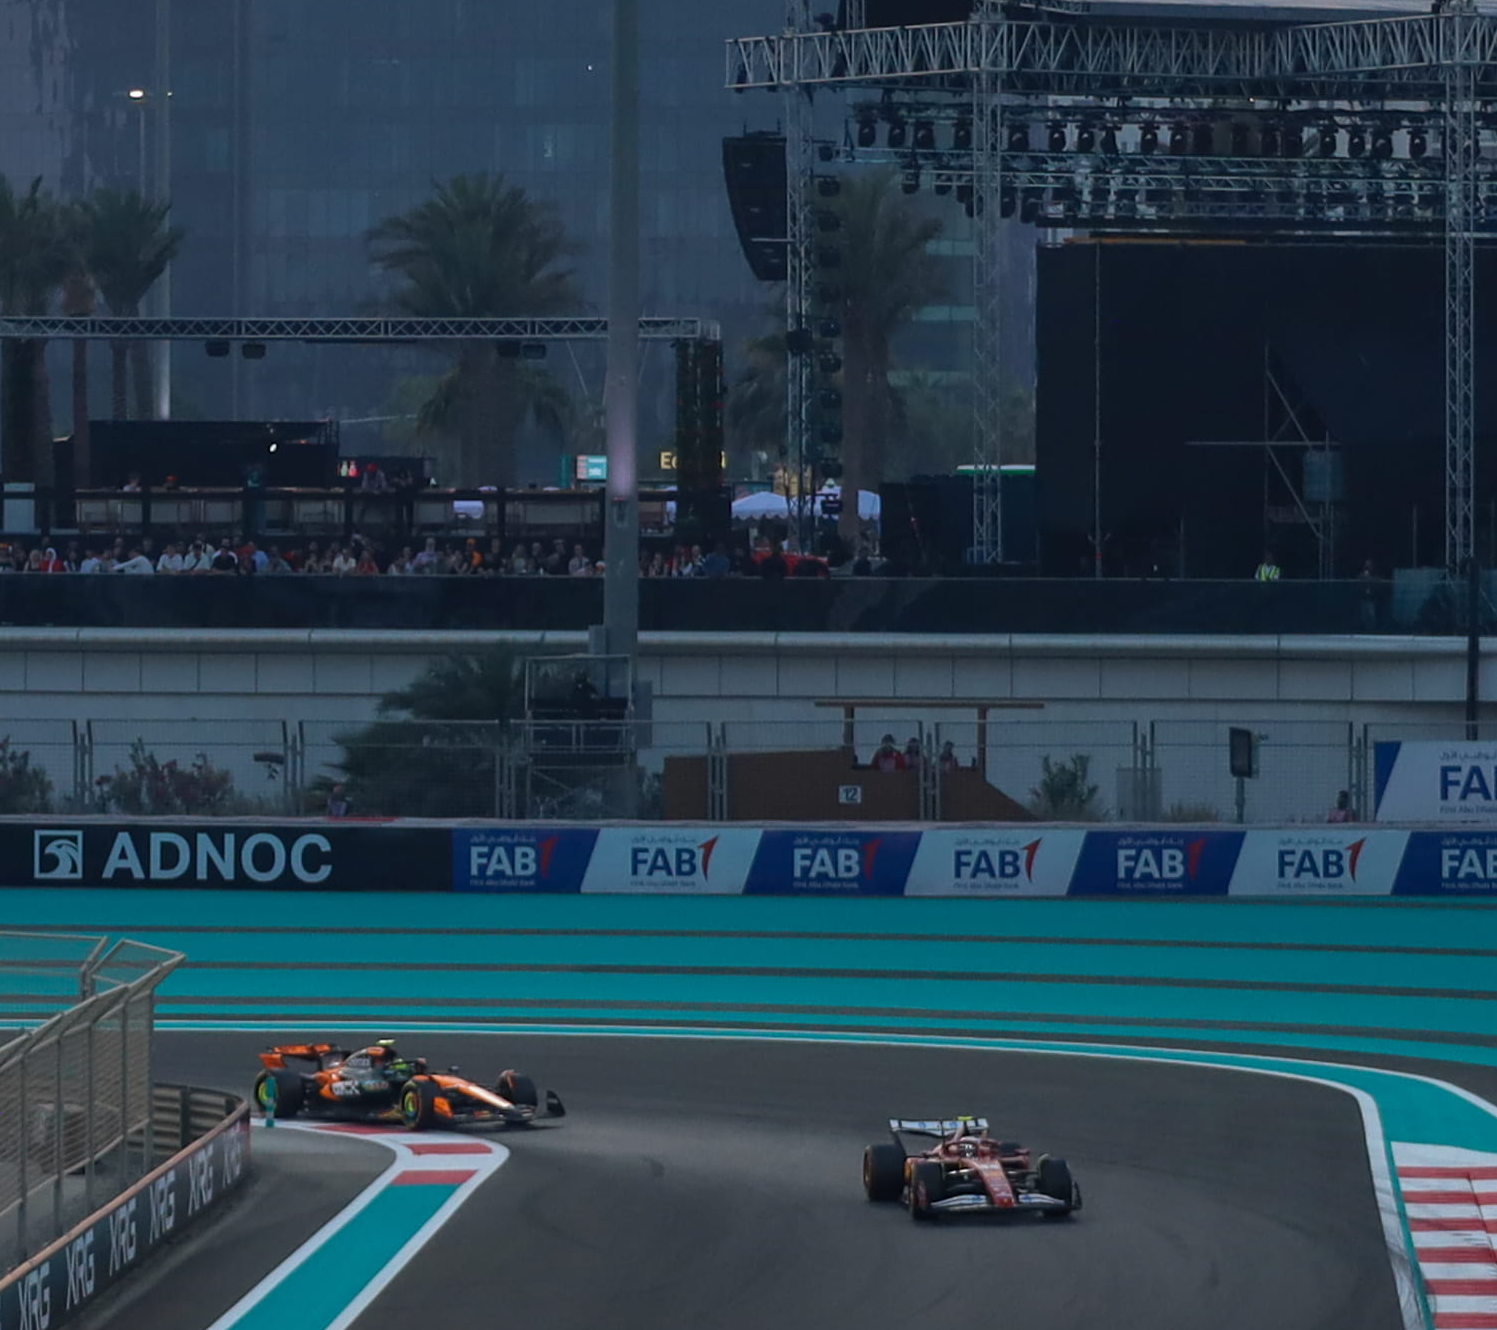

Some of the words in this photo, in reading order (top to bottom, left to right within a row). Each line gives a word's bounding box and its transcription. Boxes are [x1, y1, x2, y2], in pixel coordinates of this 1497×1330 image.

[843, 787, 857, 802] 12
[101, 831, 333, 883] ADNOC
[470, 845, 538, 877] FAB
[631, 847, 697, 877] FAB
[793, 848, 861, 878] FAB
[954, 850, 1021, 879] FAB
[1117, 848, 1185, 879] FAB
[1278, 849, 1344, 879] FAB
[149, 1170, 175, 1245] XRG
[108, 1197, 137, 1277] XRG
[65, 1230, 95, 1310] XRG
